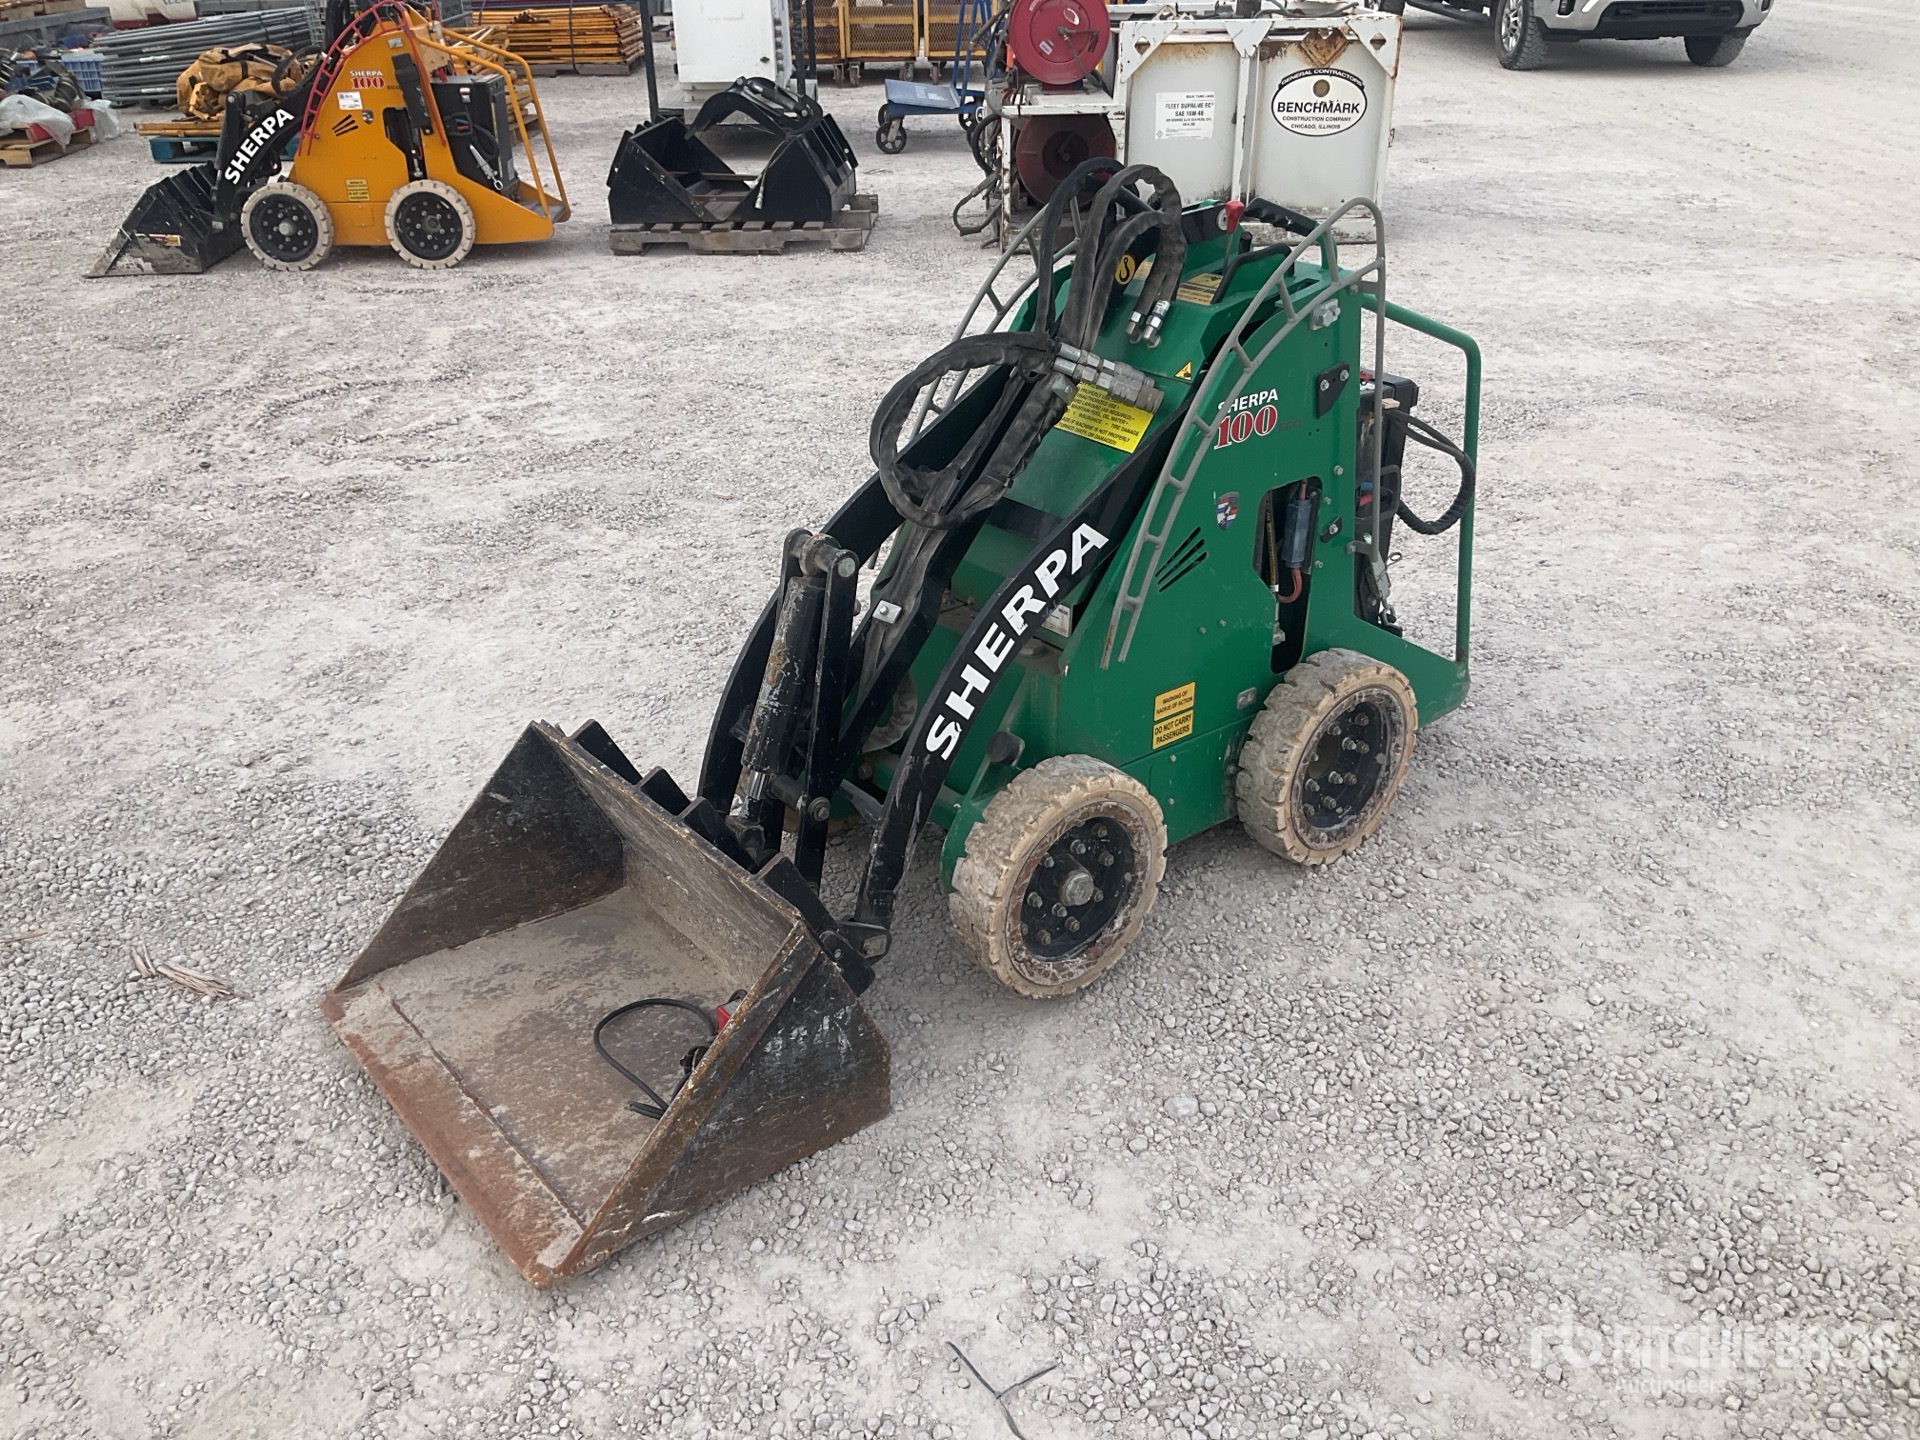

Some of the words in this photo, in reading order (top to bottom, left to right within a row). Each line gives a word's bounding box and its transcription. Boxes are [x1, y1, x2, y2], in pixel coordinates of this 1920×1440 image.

[351, 76, 385, 90] 100
[1281, 69, 1312, 86] GENERAL
[1313, 68, 1363, 87] CONTRACTORS
[1277, 101, 1360, 114] BENCHMARK
[224, 108, 294, 185] SHERPA
[1213, 404, 1278, 450] 100
[926, 523, 1109, 761] SHERPA
[1178, 696, 1193, 706] ACTION
[1155, 726, 1162, 735] DO
[1163, 720, 1174, 731] NOT
[1175, 714, 1191, 727] CARRY
[1156, 725, 1190, 745] PASSENGERS
